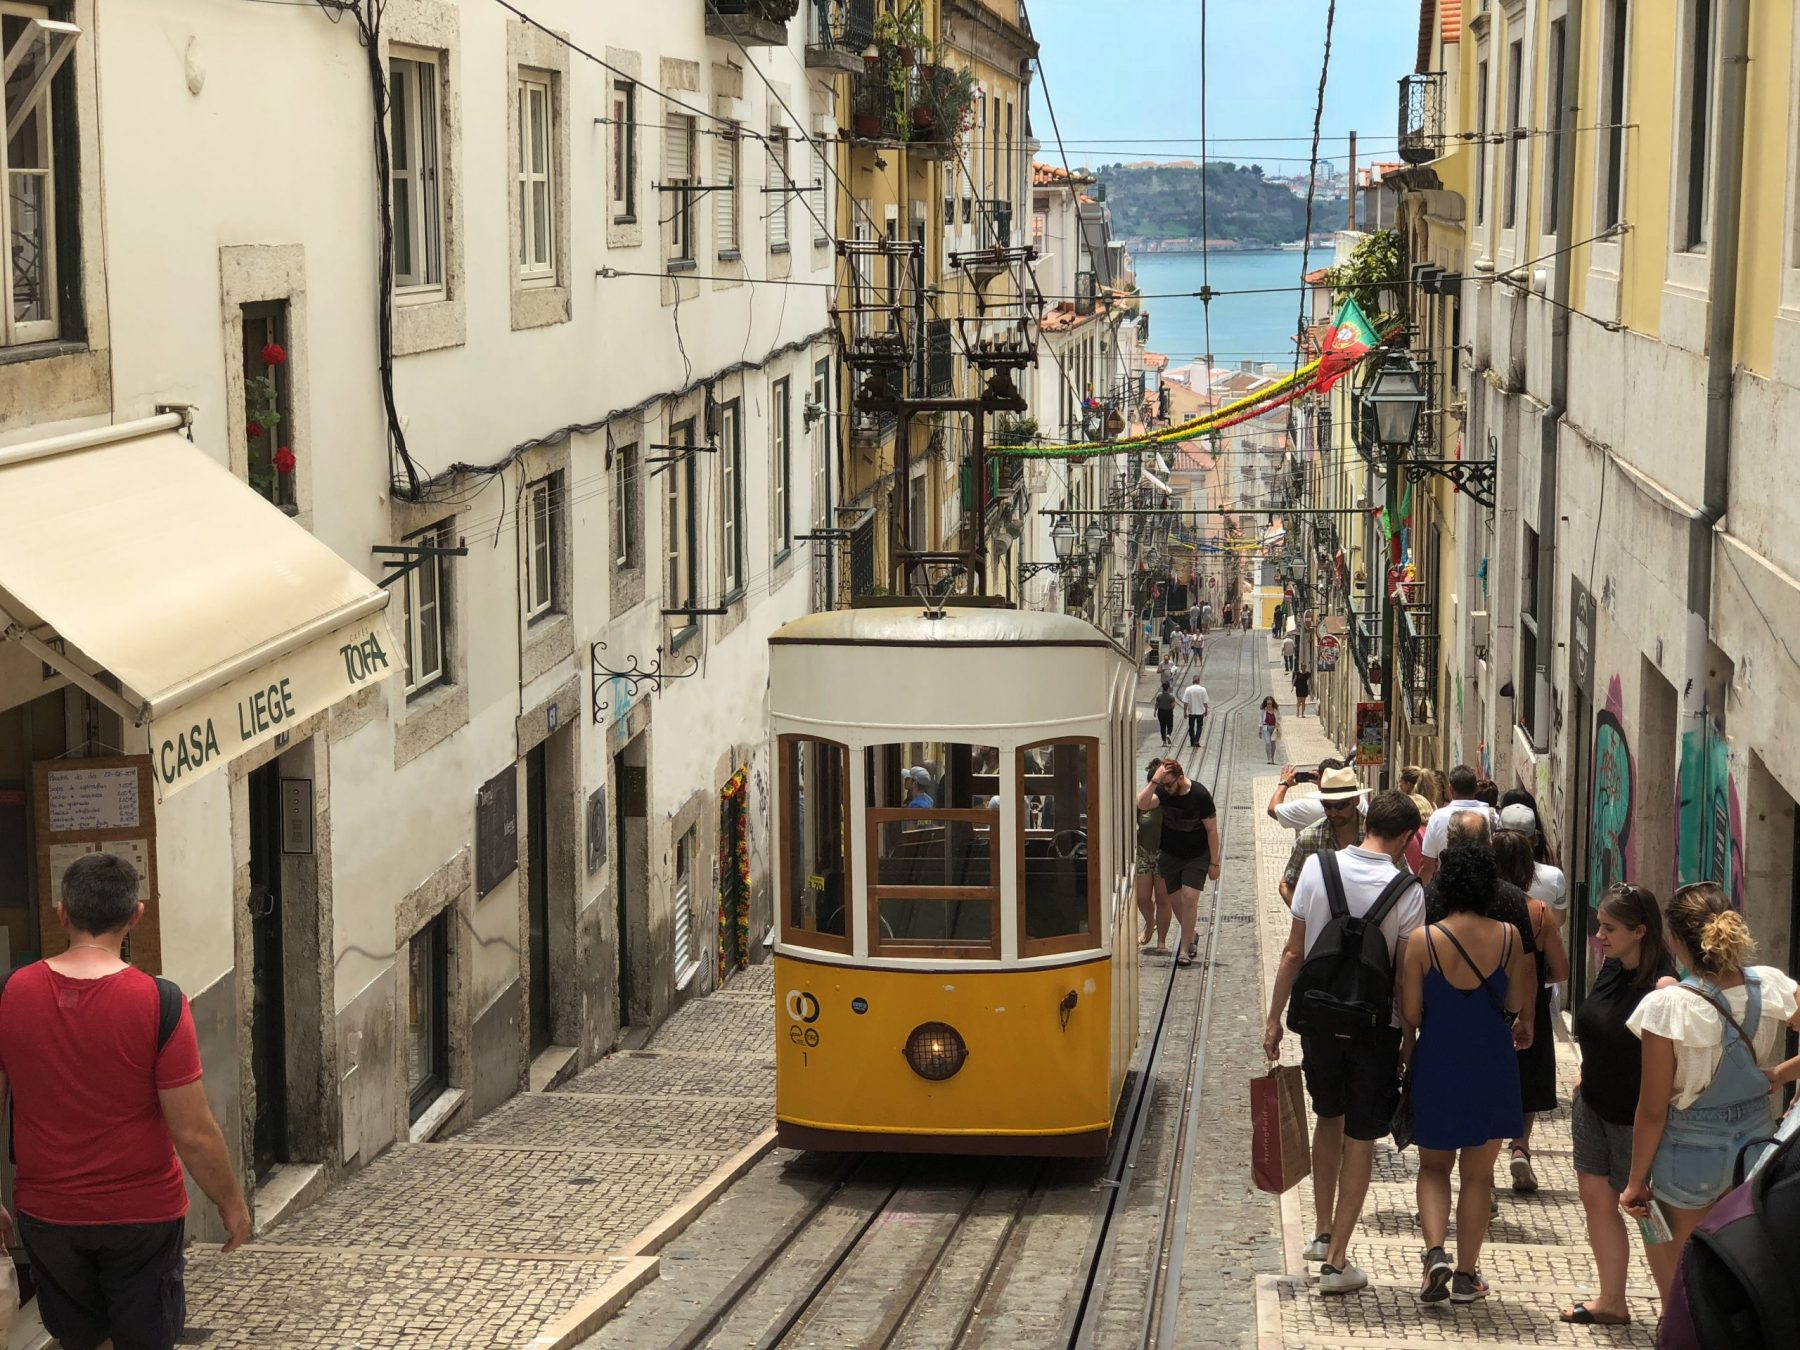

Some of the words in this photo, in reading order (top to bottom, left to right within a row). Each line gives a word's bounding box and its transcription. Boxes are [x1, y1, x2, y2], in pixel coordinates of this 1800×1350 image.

[340, 631, 389, 684] TOFA
[161, 718, 220, 784] CASA
[238, 677, 295, 741] LIEGE
